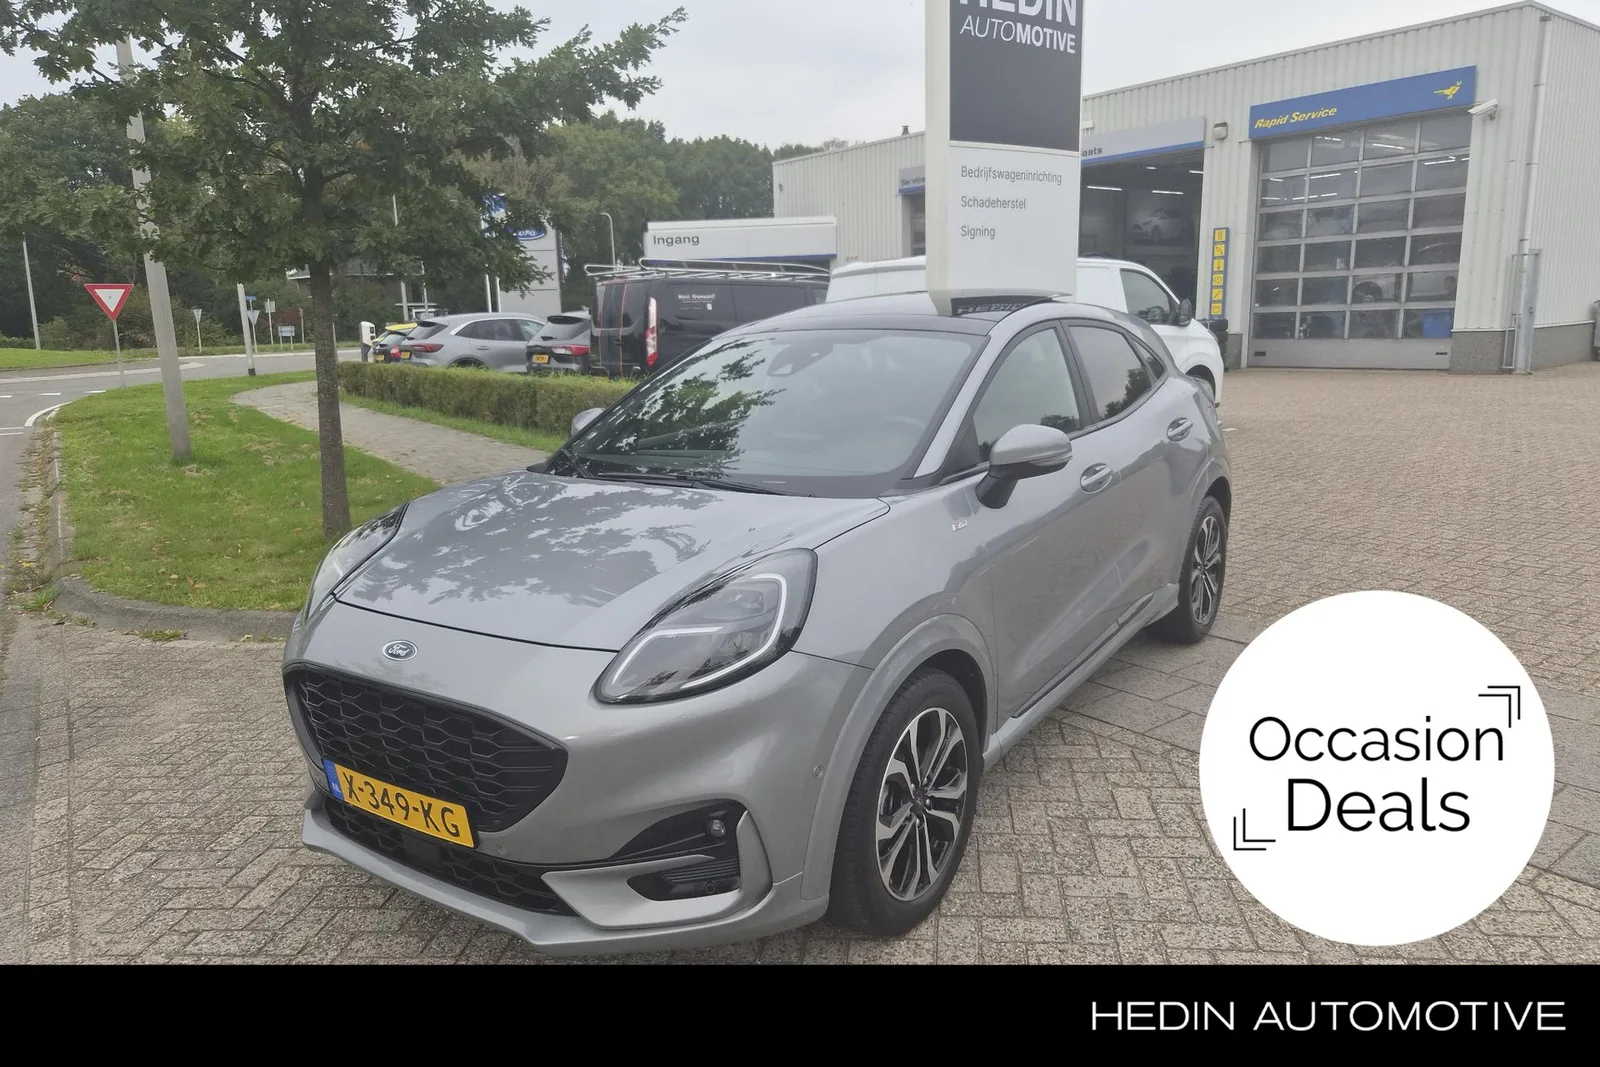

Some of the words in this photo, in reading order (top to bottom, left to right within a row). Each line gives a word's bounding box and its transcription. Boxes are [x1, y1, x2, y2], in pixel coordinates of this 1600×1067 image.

[960, 15, 1076, 54] AUTOMOTIVE
[1254, 114, 1290, 129] Rapid
[1290, 107, 1337, 123] Service
[960, 165, 1062, 186] Bedrijfswageninrichting
[960, 195, 1026, 210] Schadeherstel
[653, 235, 700, 247] Ingang
[960, 225, 996, 240] Signing
[342, 771, 461, 838] X-349-KG
